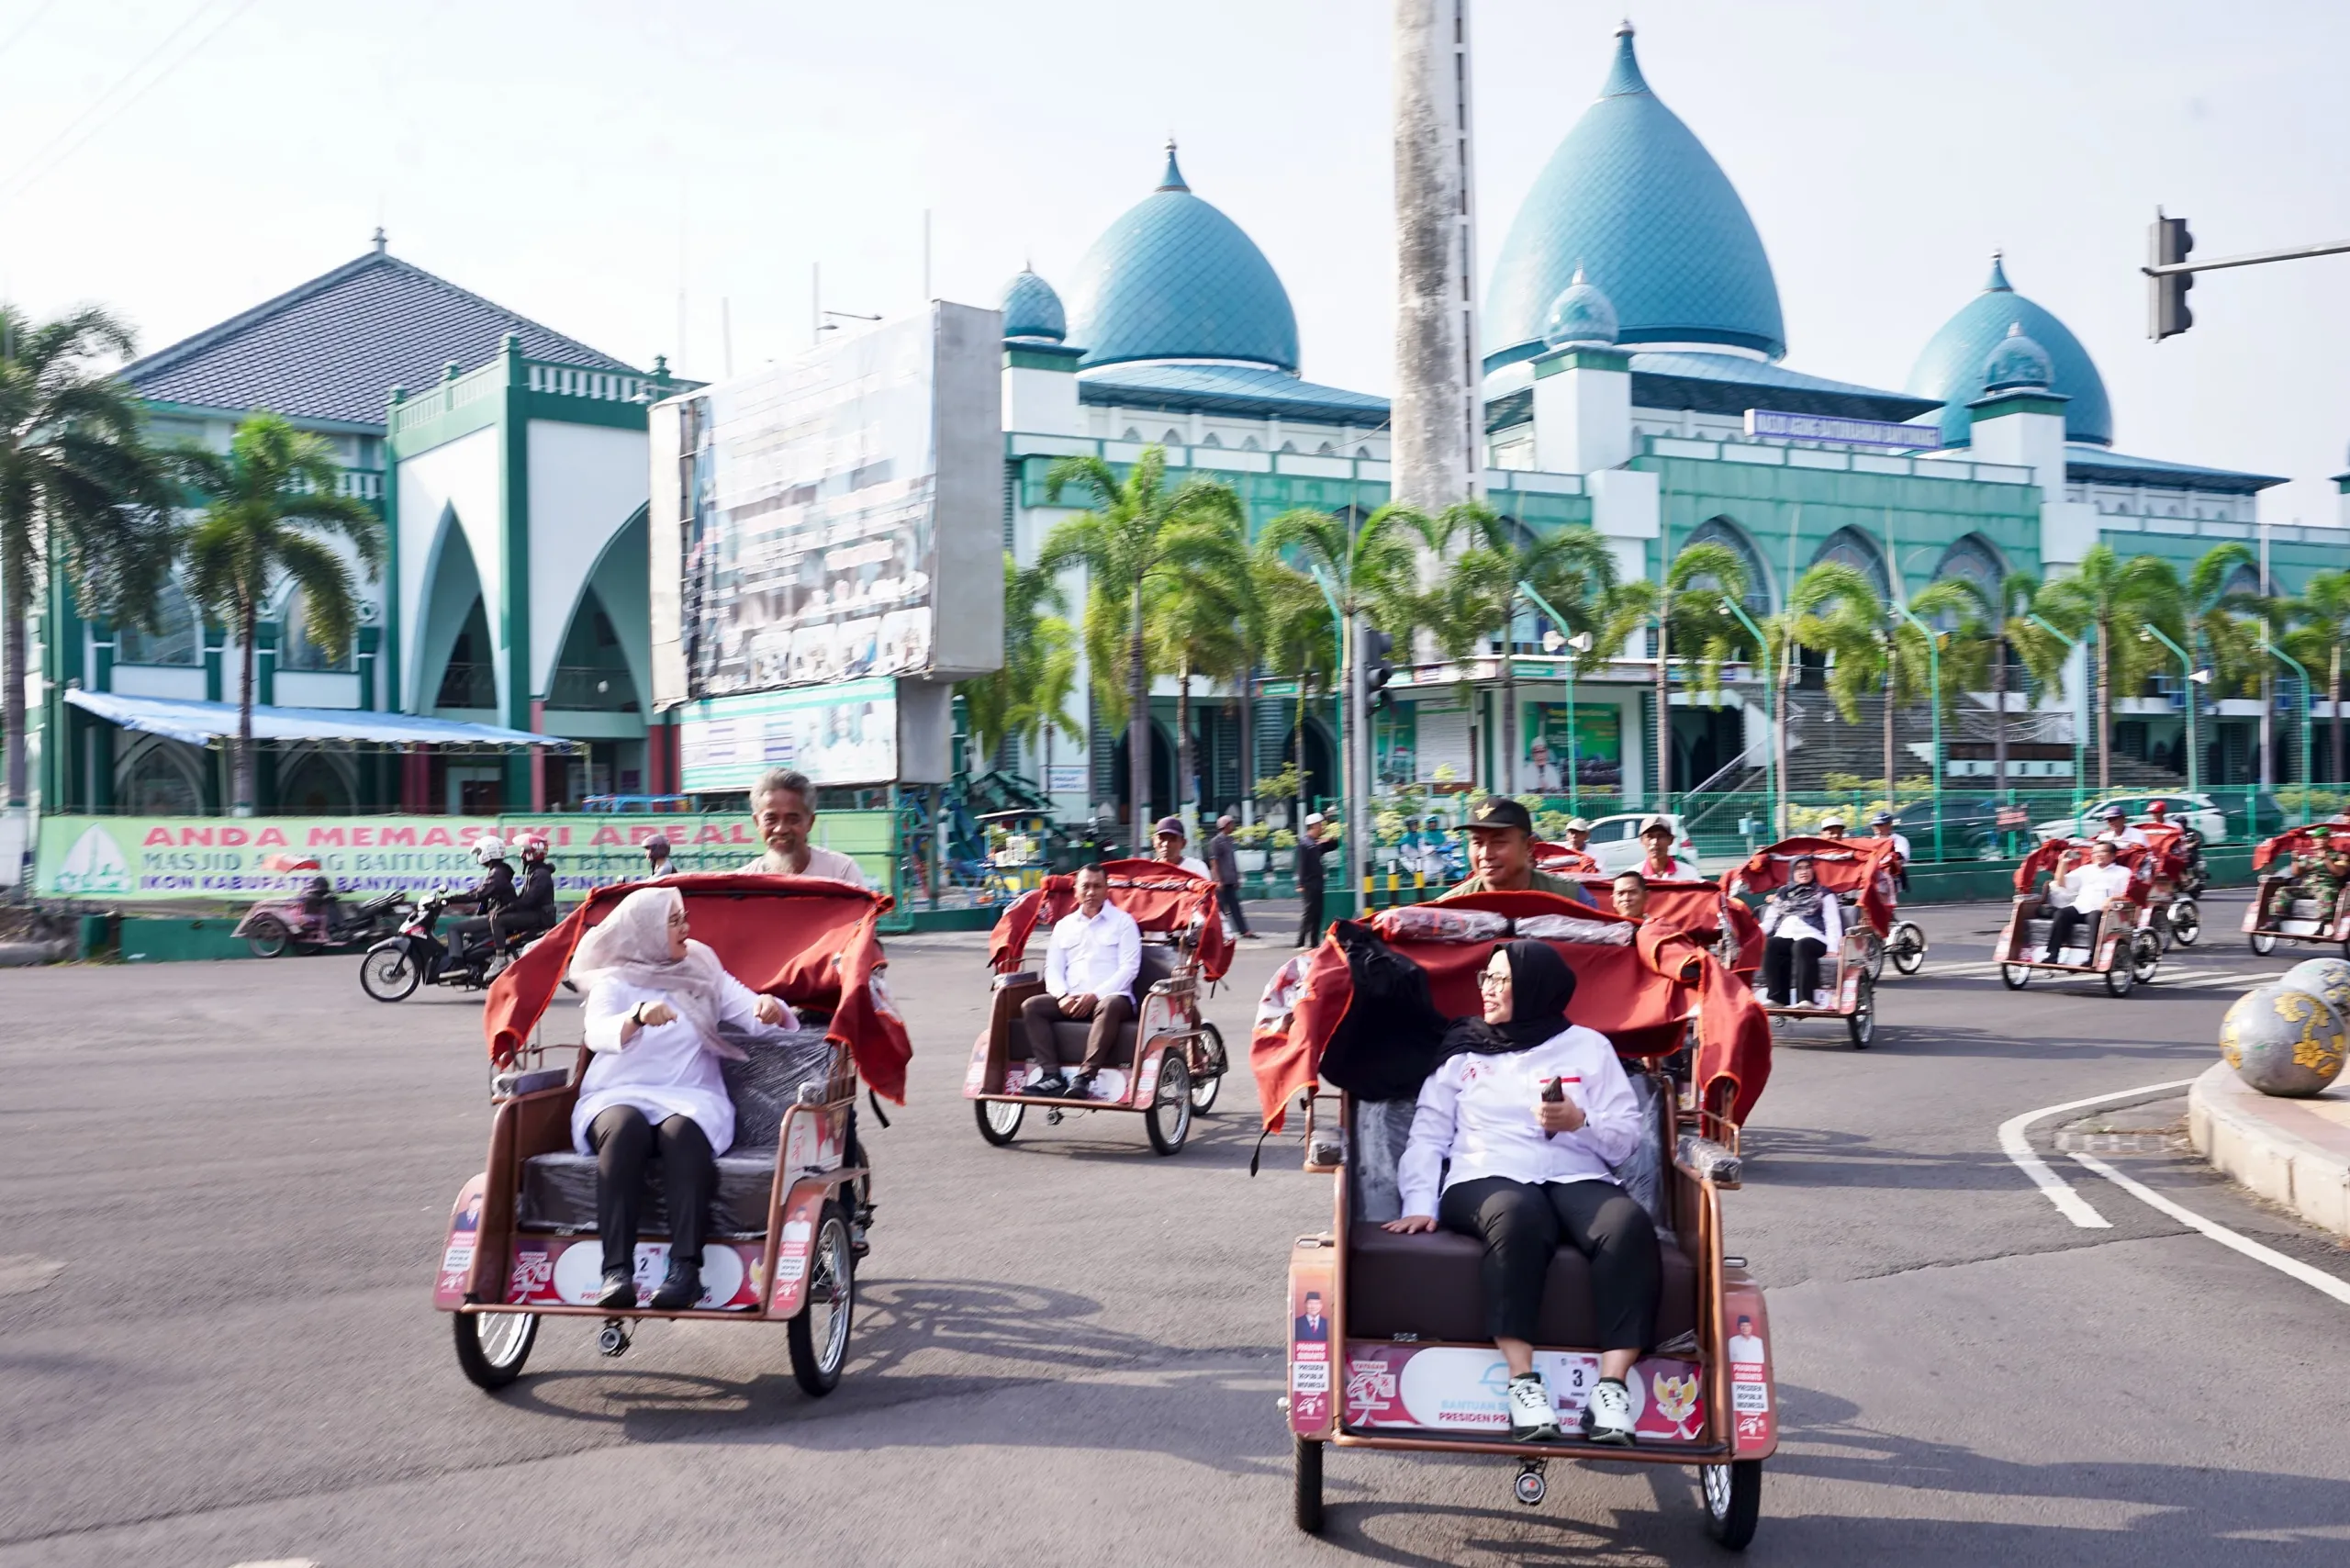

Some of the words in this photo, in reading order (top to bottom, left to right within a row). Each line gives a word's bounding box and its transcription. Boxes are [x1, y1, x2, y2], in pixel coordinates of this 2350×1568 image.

[142, 827, 288, 847] ANDA
[589, 824, 755, 846] AREAL
[142, 853, 242, 871] MASJID
[140, 876, 195, 890] IKON
[200, 876, 313, 890] KABUPAT
[336, 876, 485, 890] BANYUWANG
[640, 1257, 649, 1272] 2
[1572, 1369, 1583, 1387] 3
[1438, 1412, 1491, 1422] PRESIDEN
